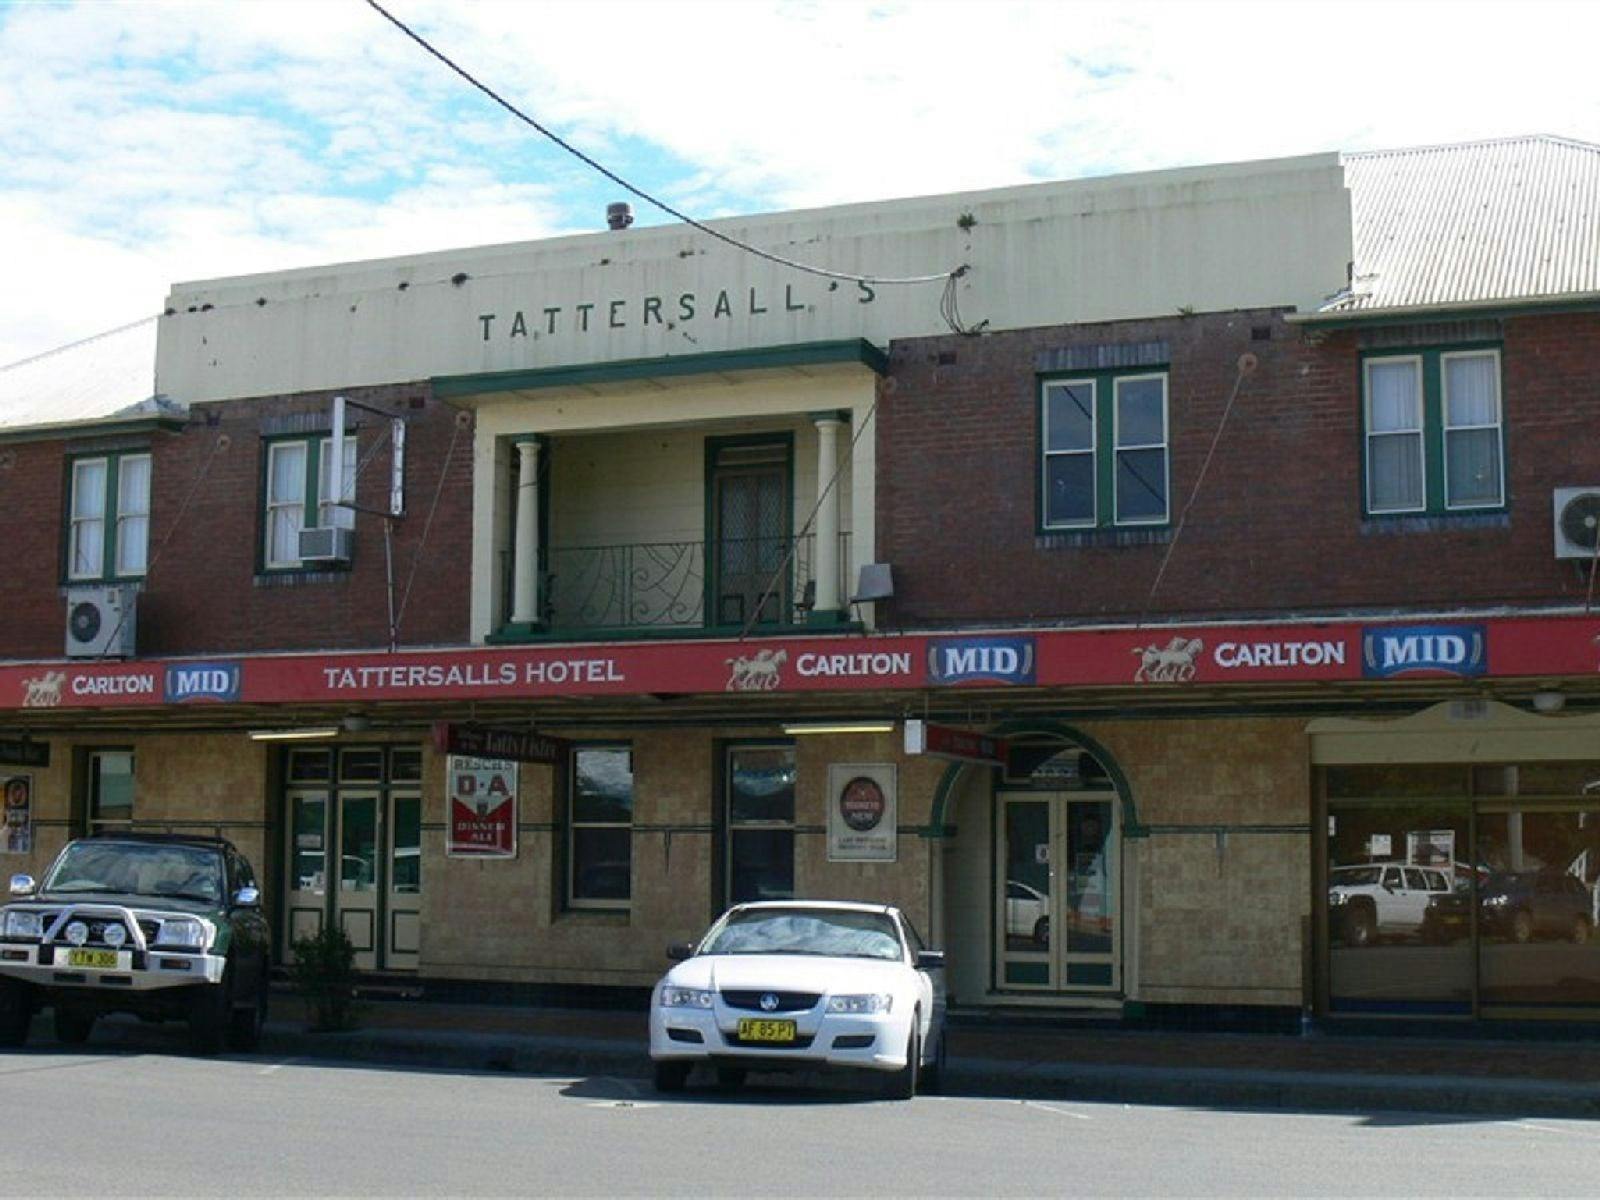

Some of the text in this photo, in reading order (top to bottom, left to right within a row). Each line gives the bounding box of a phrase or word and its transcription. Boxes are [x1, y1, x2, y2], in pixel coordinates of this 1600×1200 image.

[478, 278, 876, 341] TATTERSALL'S
[795, 647, 1018, 677] CARLTON MID
[1213, 635, 1466, 668] CARLTON MID
[71, 669, 230, 696] CARLTON MID
[323, 659, 625, 688] TATTERSALLS HOTEL
